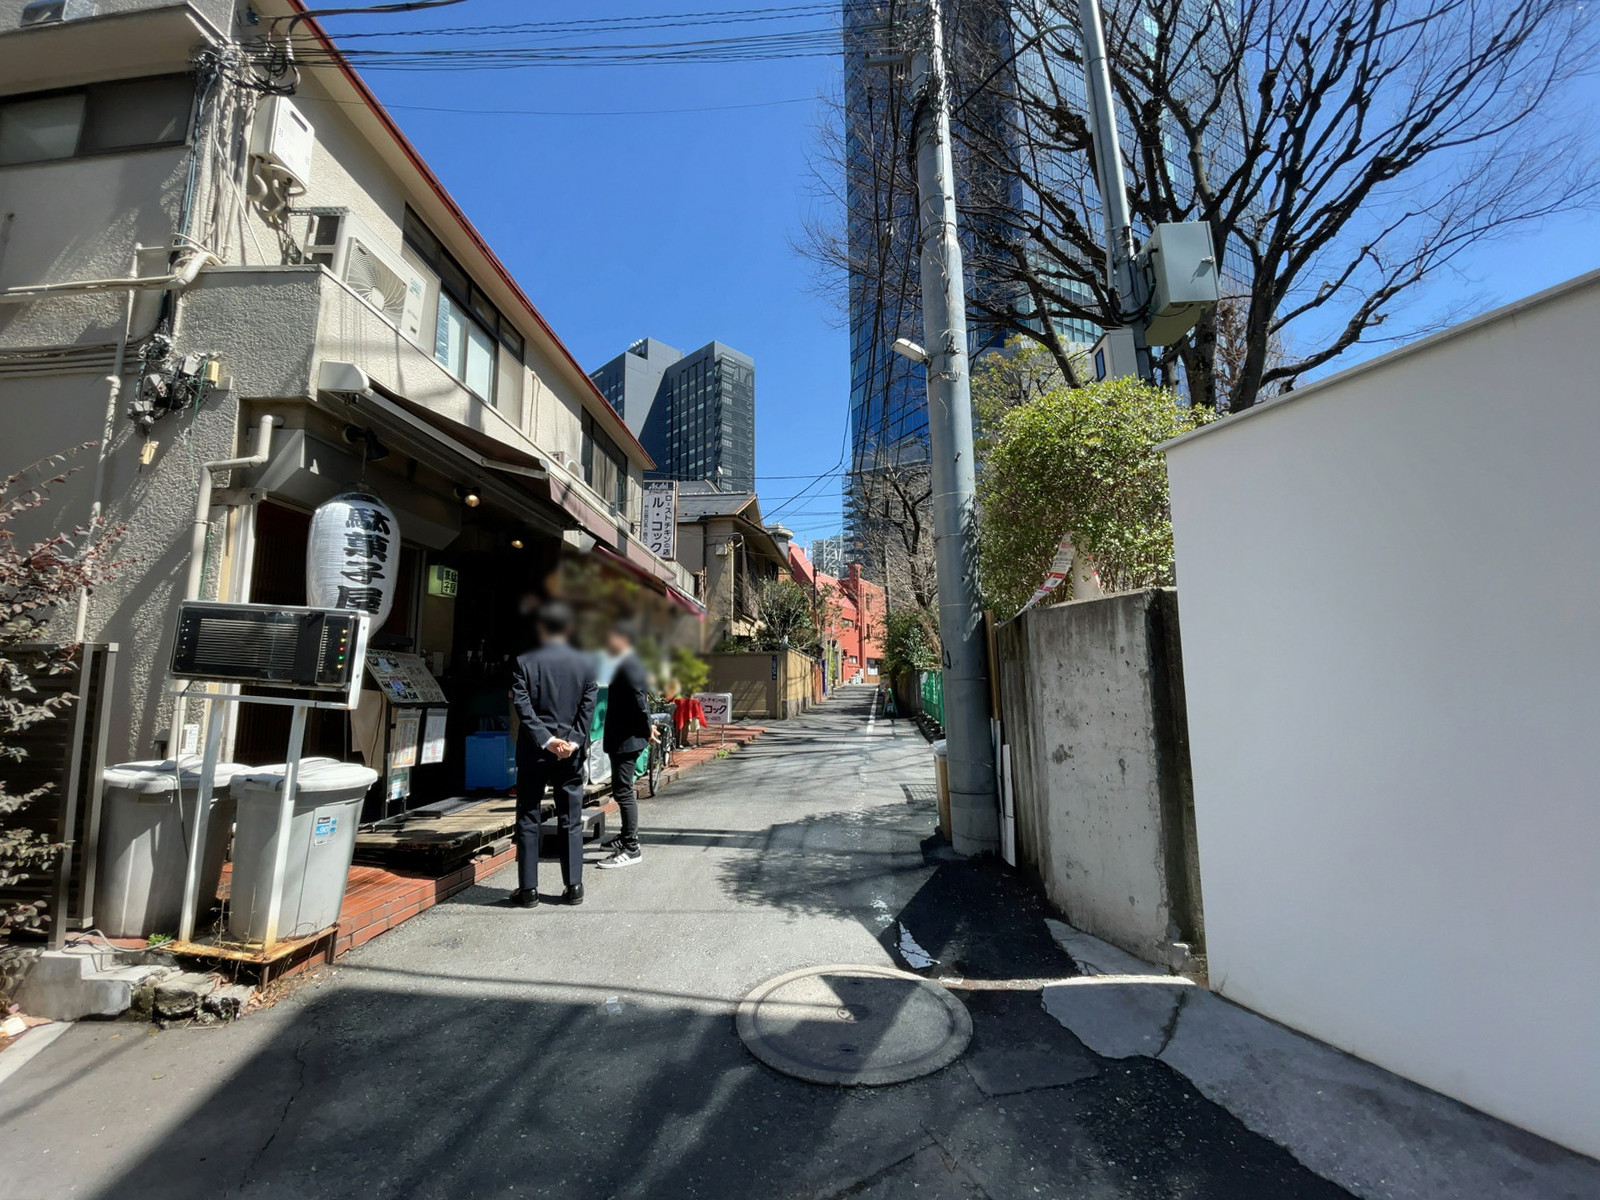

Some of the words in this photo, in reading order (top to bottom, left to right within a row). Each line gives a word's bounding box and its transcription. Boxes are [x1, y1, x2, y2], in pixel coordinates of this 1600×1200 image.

[335, 508, 391, 615] 駄菓子屋
[704, 705, 727, 714] コック
